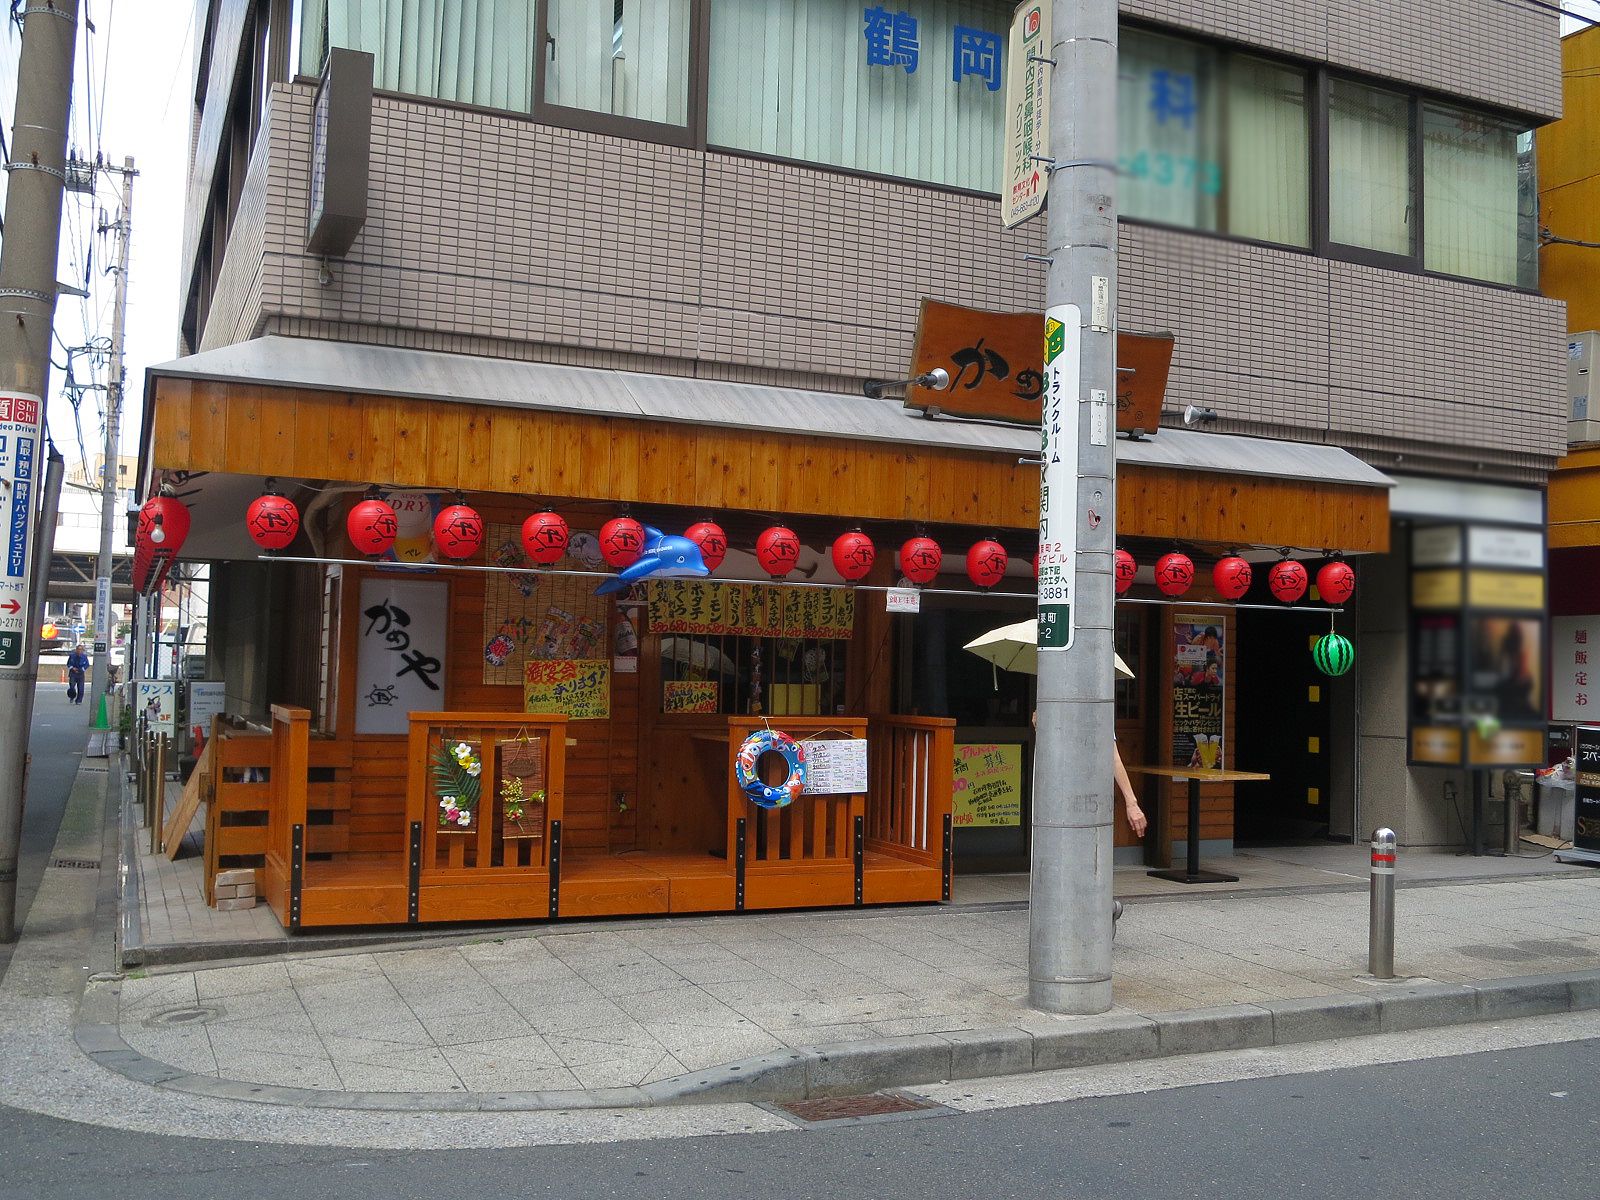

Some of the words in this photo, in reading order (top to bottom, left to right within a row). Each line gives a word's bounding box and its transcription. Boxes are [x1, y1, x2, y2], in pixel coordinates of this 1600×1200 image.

[1013, 102, 1023, 180] クリニック
[18, 400, 36, 412] Shi
[16, 411, 35, 423] Chi
[1051, 367, 1061, 464] トランクルーム
[15, 424, 37, 433] Drive
[391, 499, 429, 512] DRY
[729, 587, 741, 626] おにぎり
[141, 684, 173, 696] ダンス
[1174, 701, 1222, 718] 生ビール
[159, 713, 171, 721] 3F
